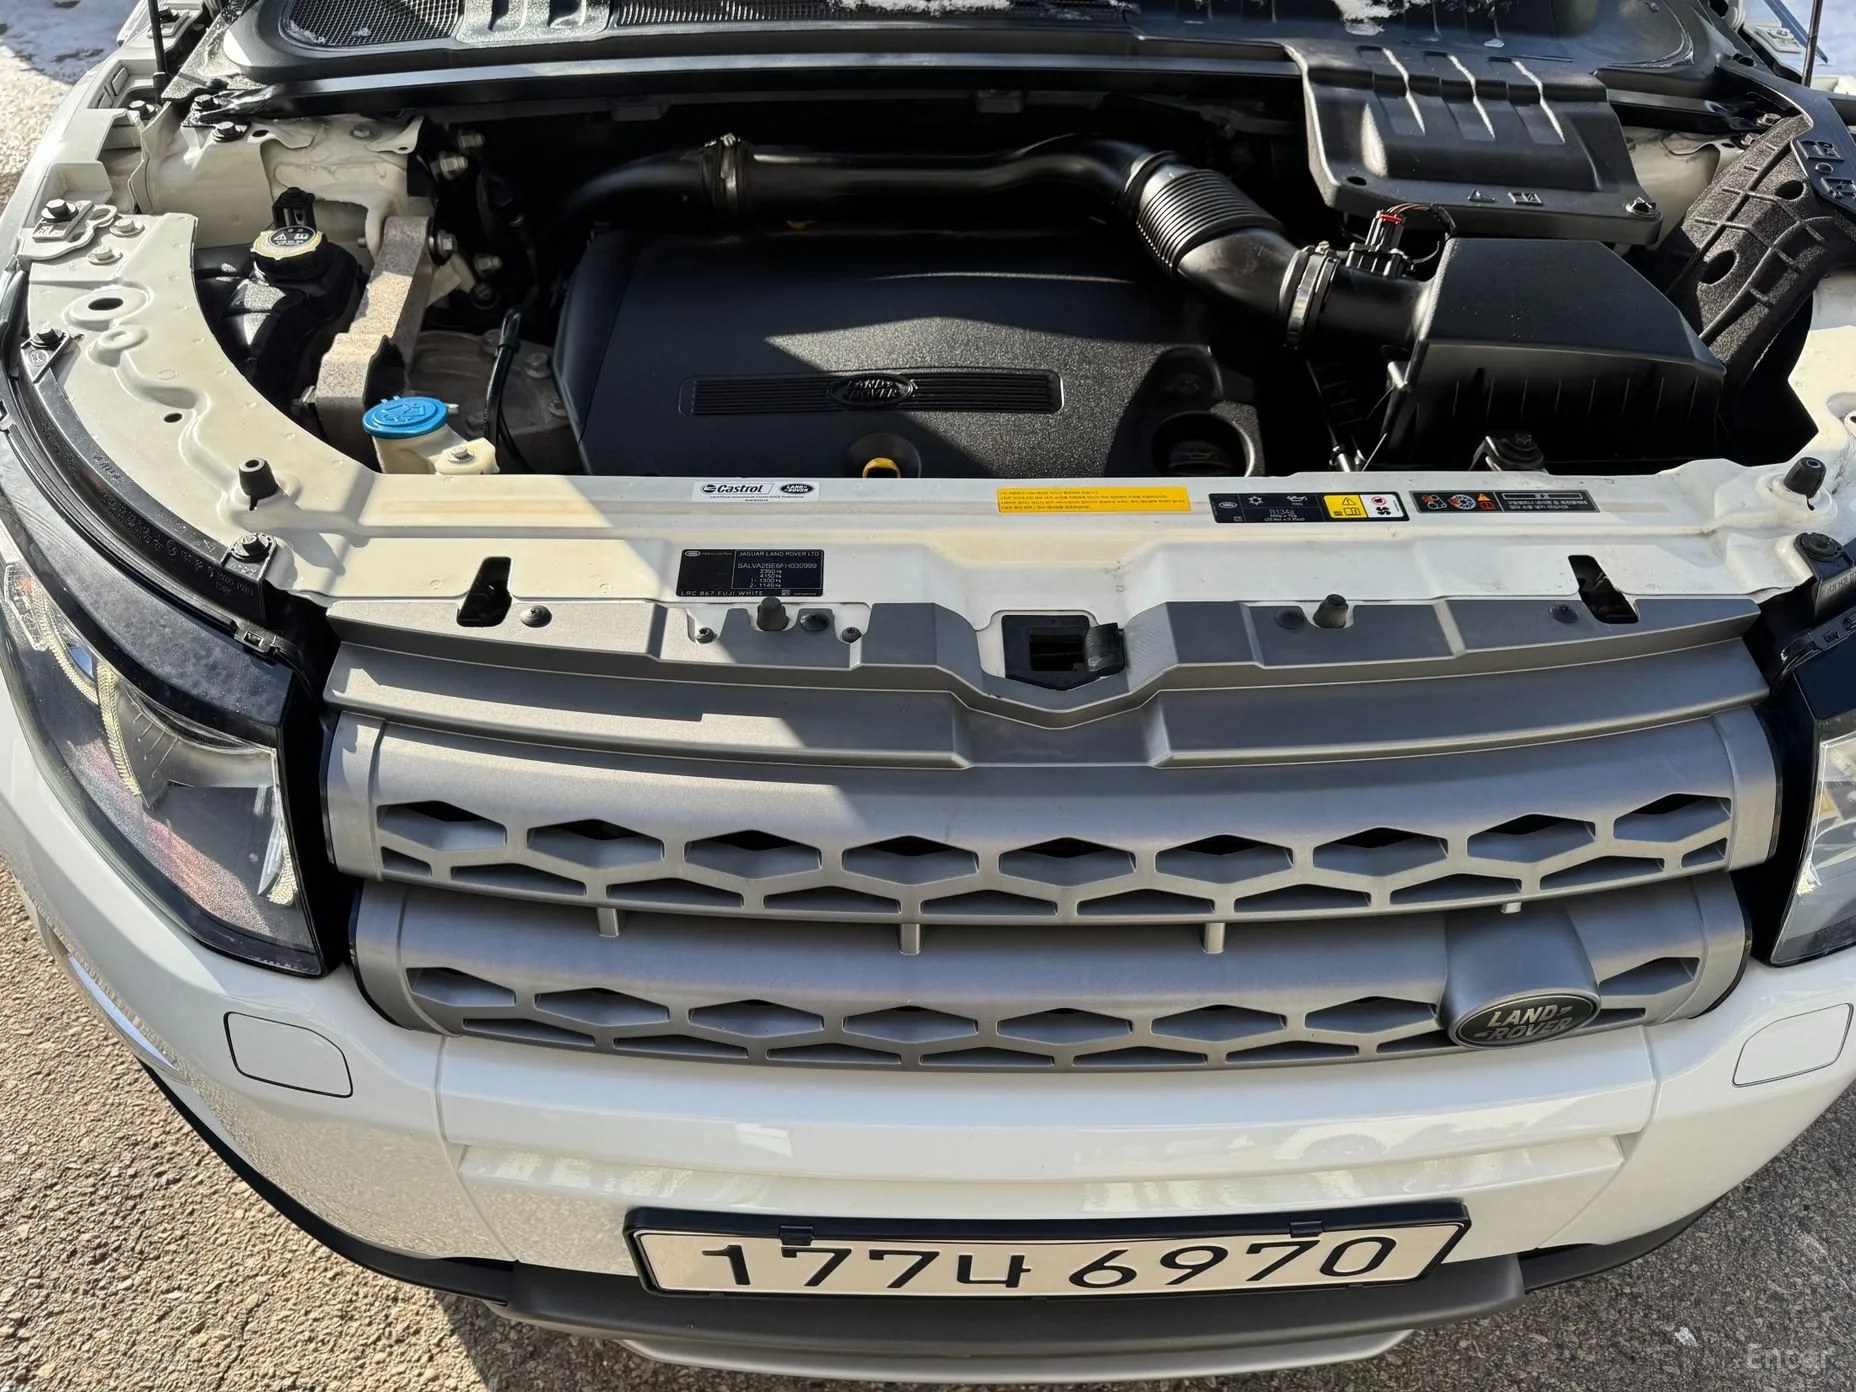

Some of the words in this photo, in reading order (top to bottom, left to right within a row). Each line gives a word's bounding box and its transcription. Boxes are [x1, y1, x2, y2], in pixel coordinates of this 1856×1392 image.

[717, 484, 764, 493] Castrol
[1488, 1004, 1558, 1027] LAND
[1488, 1017, 1573, 1041] ROVER
[702, 1244, 1031, 1289] 177나
[1069, 1236, 1397, 1289] 6970
